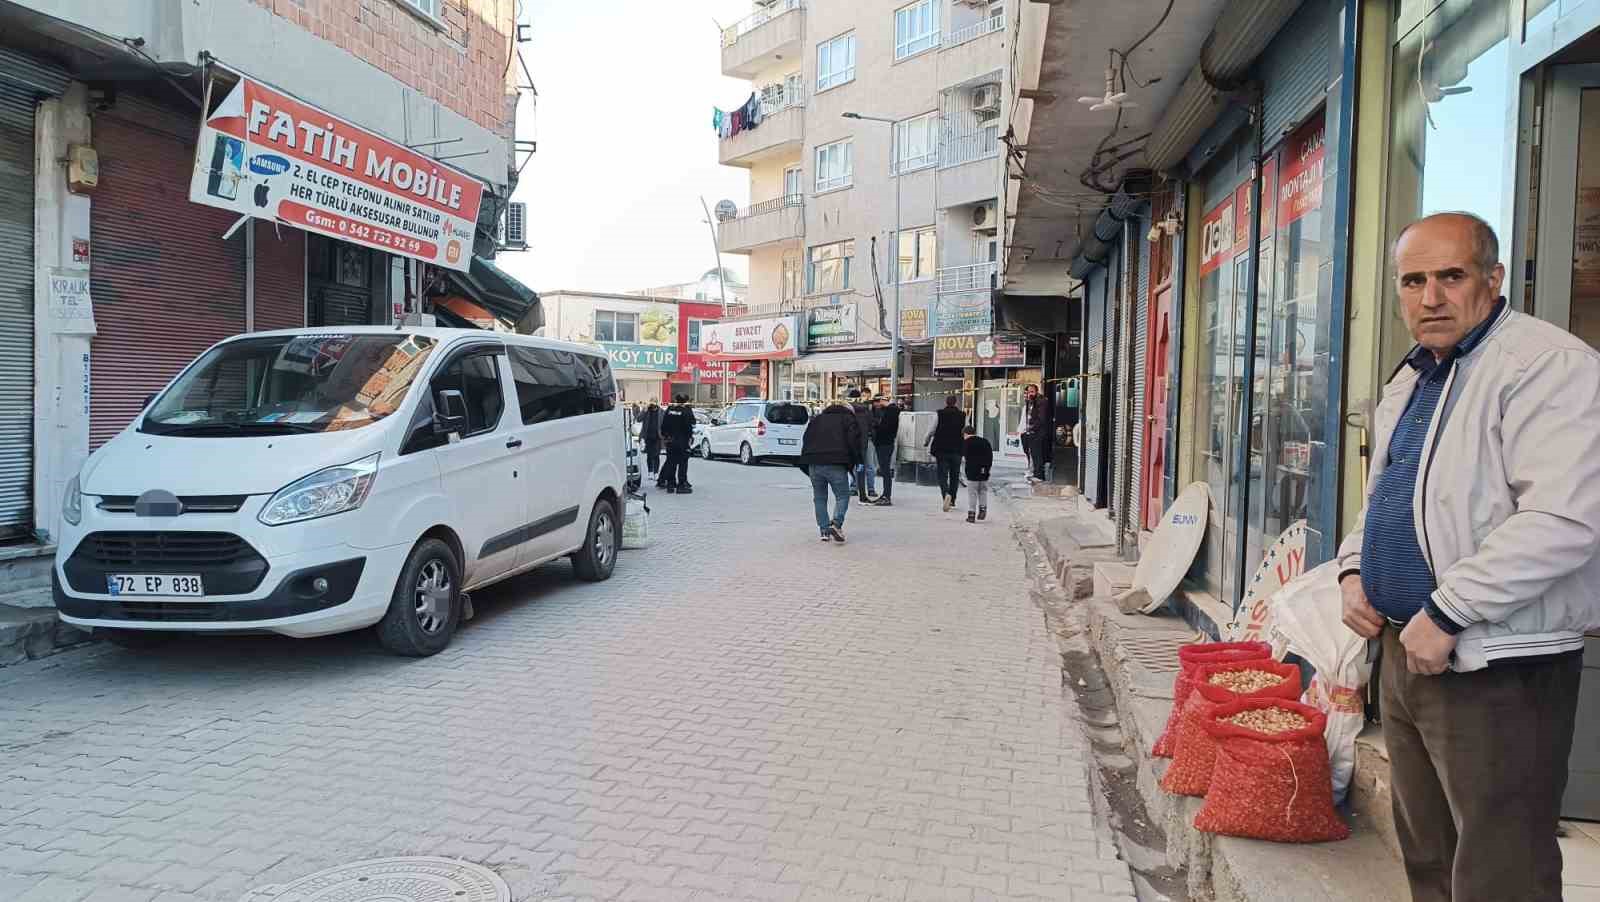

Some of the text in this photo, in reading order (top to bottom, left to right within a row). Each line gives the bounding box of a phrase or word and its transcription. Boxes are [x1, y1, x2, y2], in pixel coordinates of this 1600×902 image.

[249, 100, 463, 210] FATİH MOBİLE
[289, 183, 440, 240] HER TÜRLÜ AKSESUSAR BULUNUR
[293, 164, 441, 224] 2. EL CEP TELFONU ALINIR SATILIR
[305, 210, 336, 229] Gsm:
[338, 221, 347, 232] 0
[349, 223, 370, 239] 542
[936, 336, 976, 350] NOVA
[117, 576, 136, 592] 72
[145, 576, 162, 592] EP
[172, 577, 200, 592] 838
